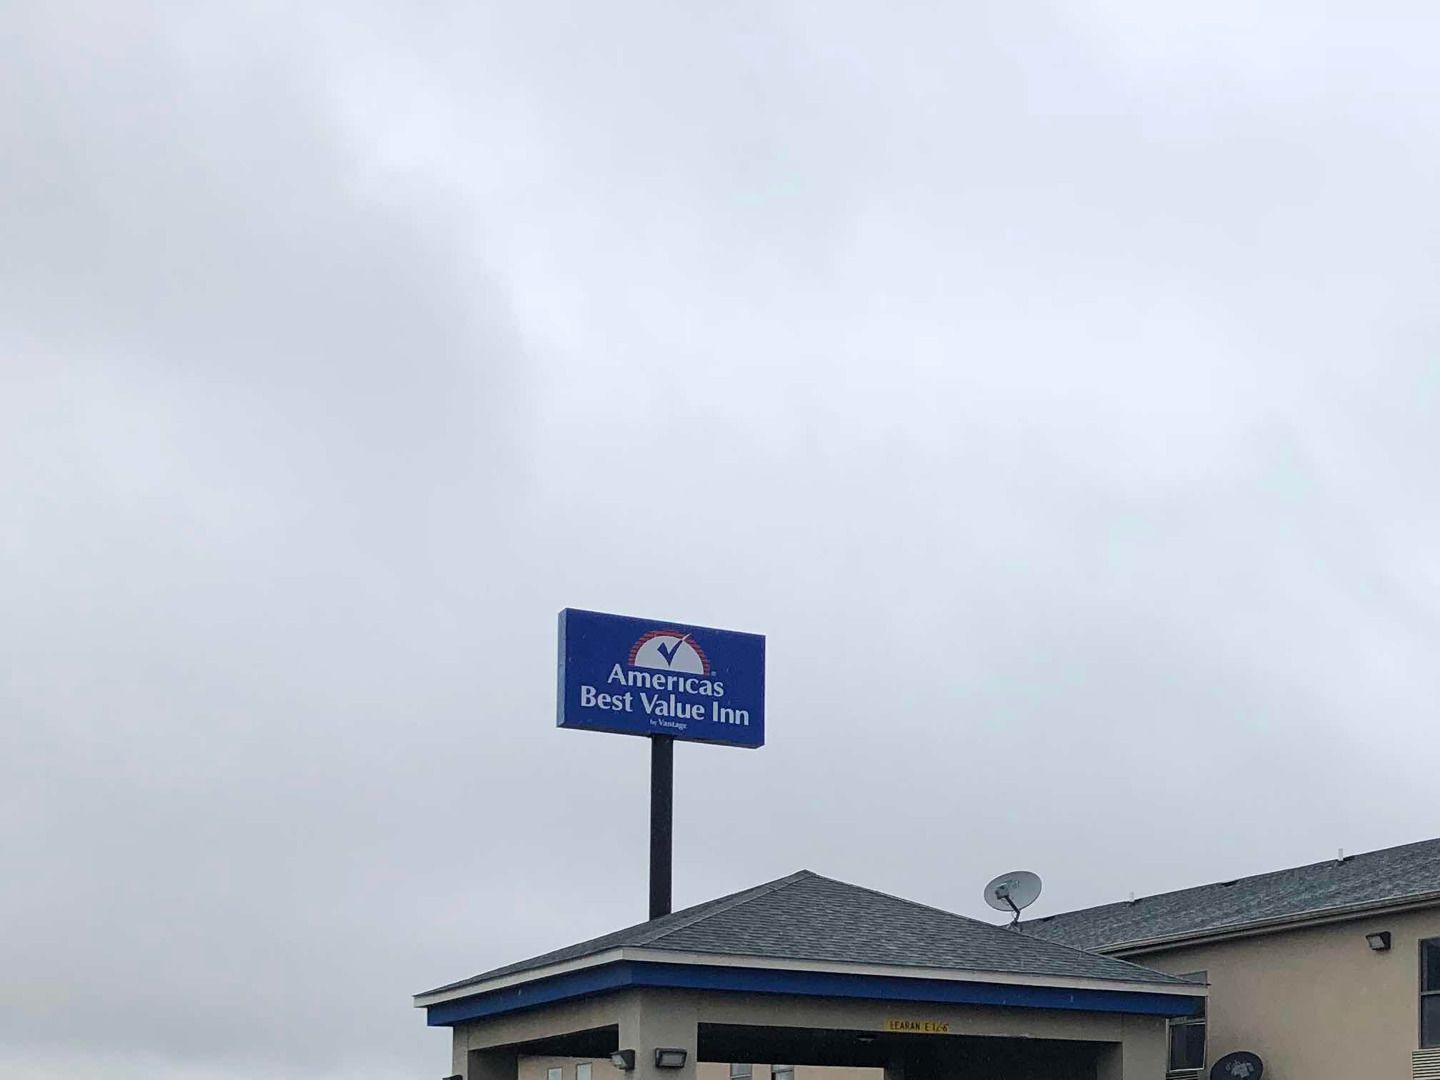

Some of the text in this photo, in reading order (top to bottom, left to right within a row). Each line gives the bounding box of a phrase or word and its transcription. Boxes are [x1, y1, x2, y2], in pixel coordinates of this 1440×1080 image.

[607, 663, 724, 697] Americas
[580, 685, 750, 726] Best Value Inn
[649, 718, 688, 730] by Vantage
